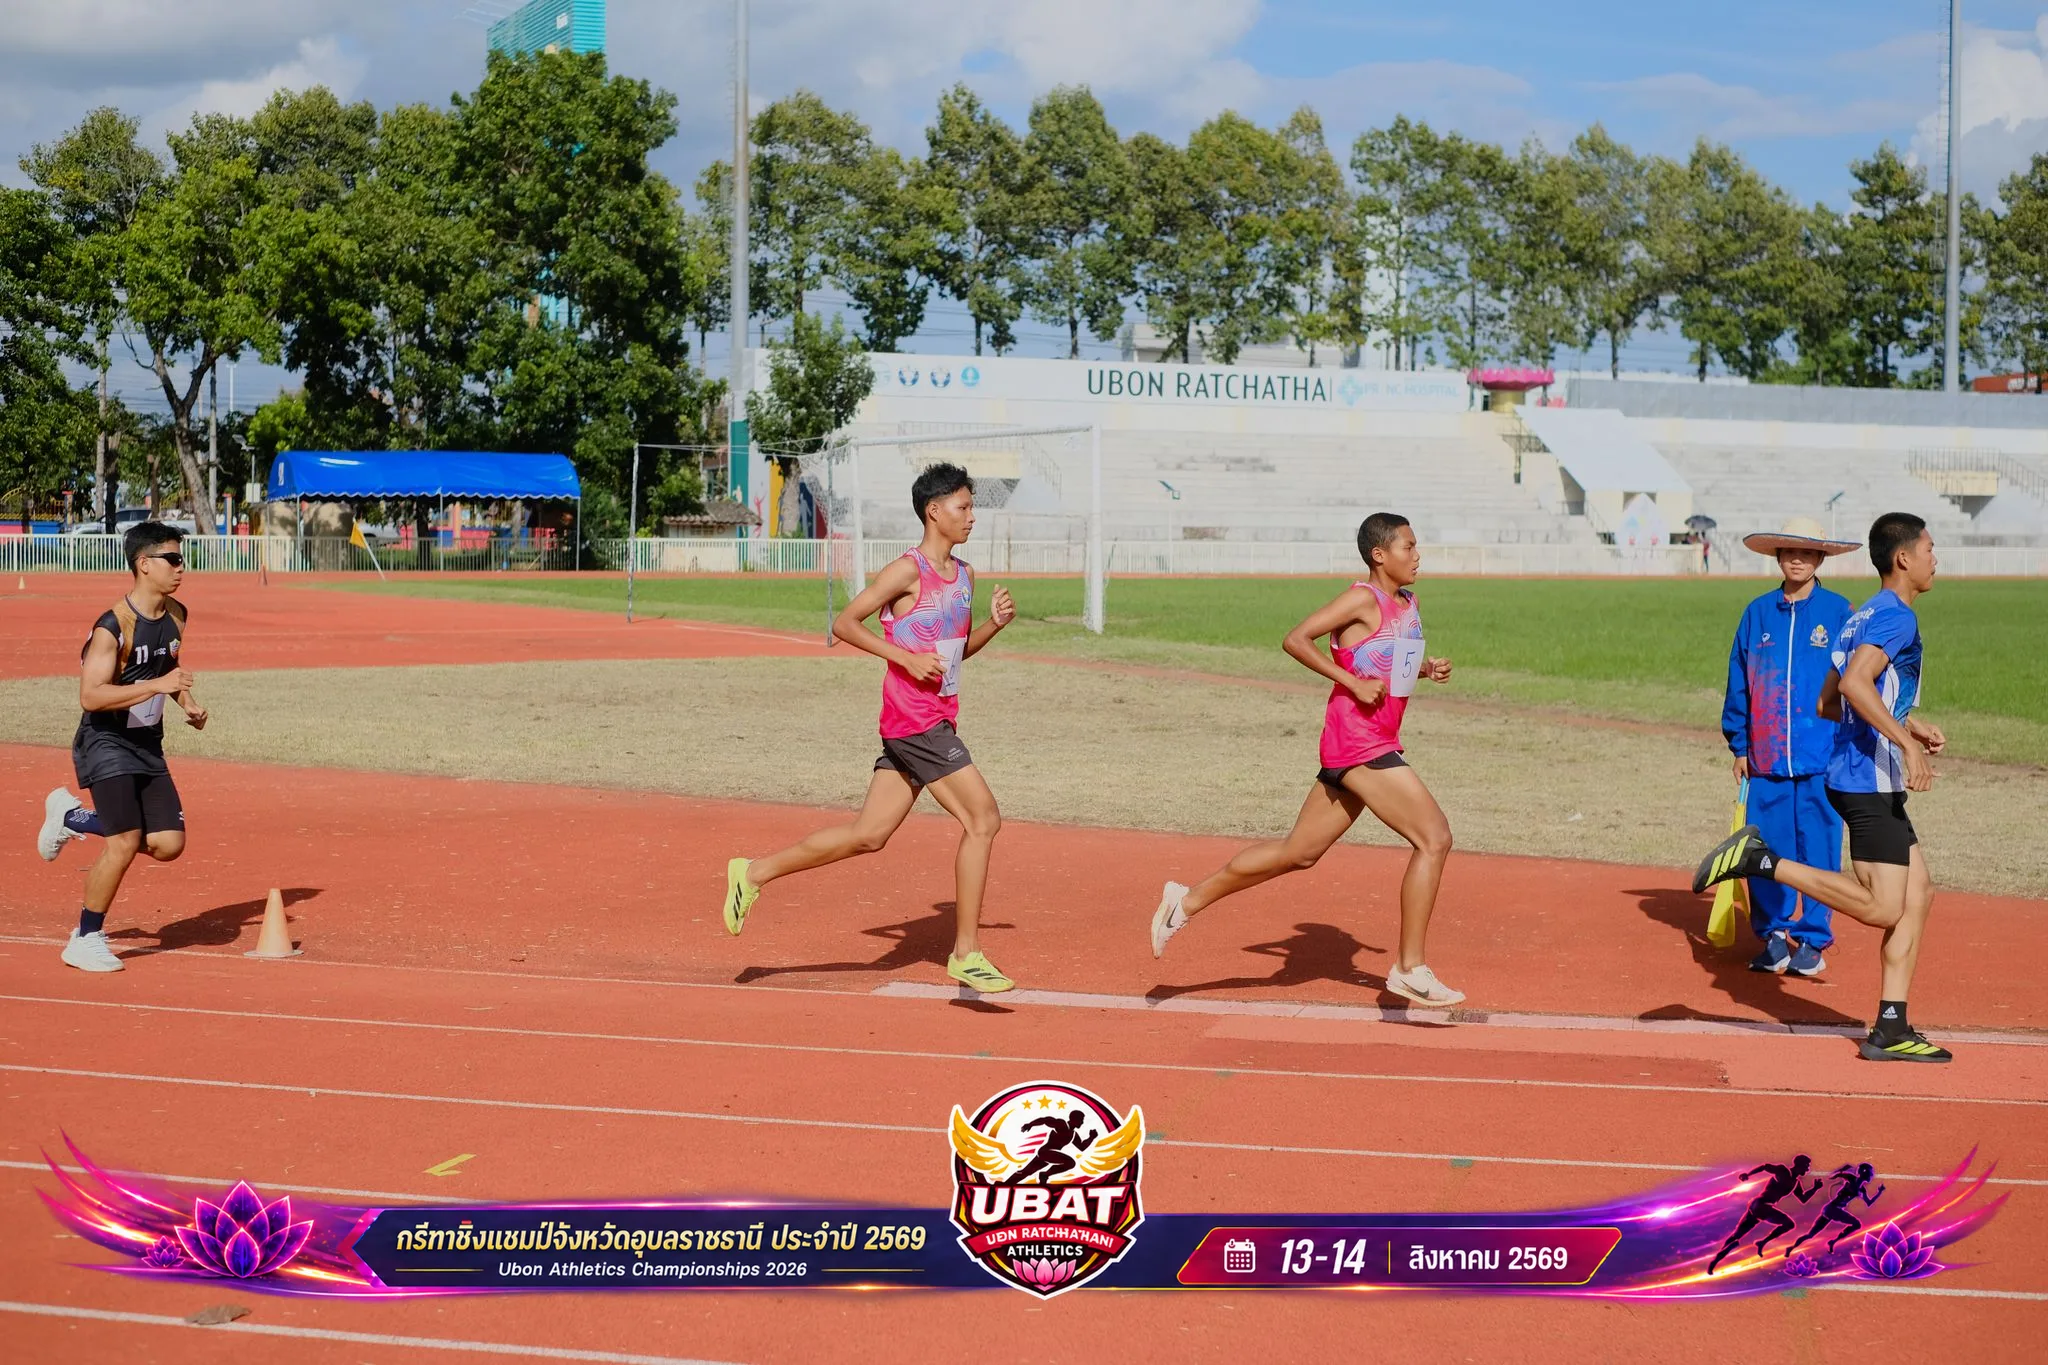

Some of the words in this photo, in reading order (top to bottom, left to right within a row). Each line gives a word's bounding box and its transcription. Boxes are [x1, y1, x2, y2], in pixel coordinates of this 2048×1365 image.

[1087, 369, 1164, 397] UBON
[1176, 372, 1333, 402] RATCHATHA
[1364, 383, 1401, 397] PRNC
[134, 644, 149, 665] 11
[1402, 651, 1416, 678] 5
